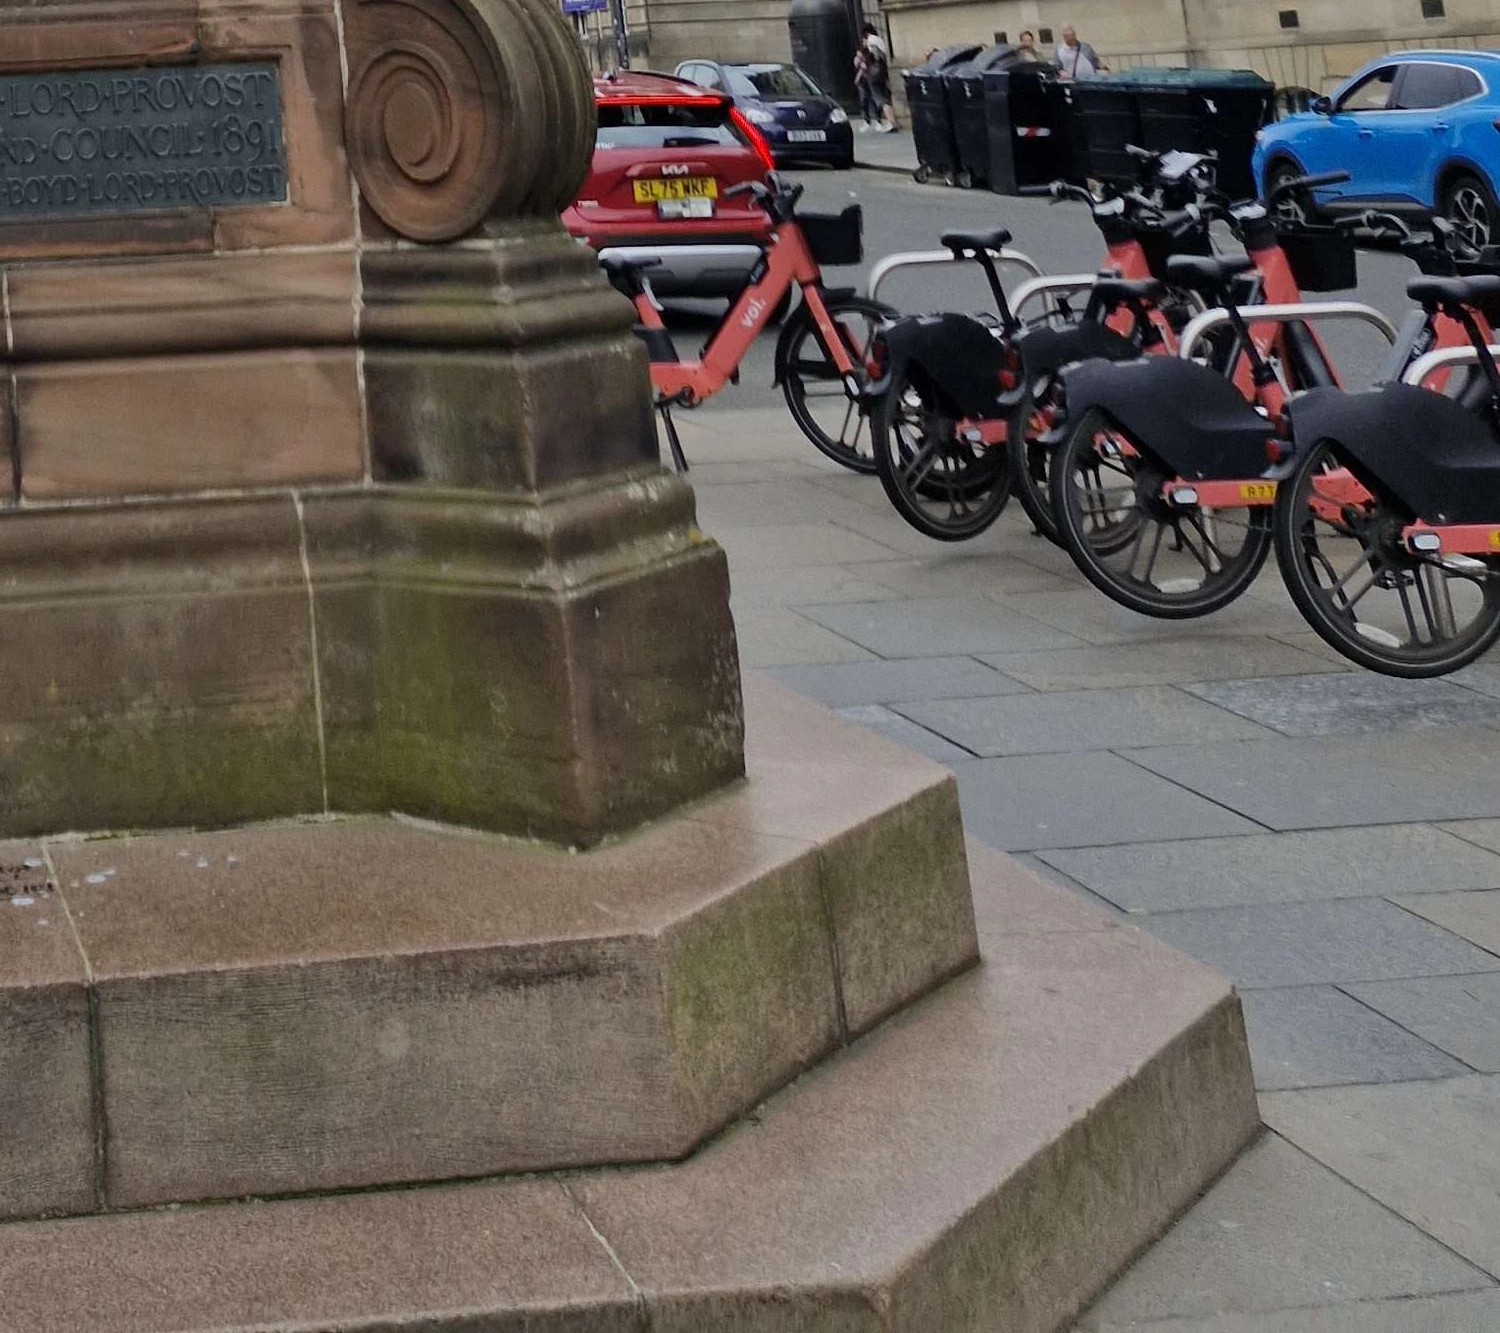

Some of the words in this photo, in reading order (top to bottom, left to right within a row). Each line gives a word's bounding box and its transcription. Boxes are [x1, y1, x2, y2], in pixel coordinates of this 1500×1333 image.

[10, 81, 100, 121] LORD
[110, 71, 273, 114] PROVOST
[51, 120, 203, 162] COUNCIL
[211, 114, 278, 162] 1891
[7, 174, 78, 206] BOYD
[87, 171, 157, 205] LORD
[162, 164, 284, 204] PROVOST
